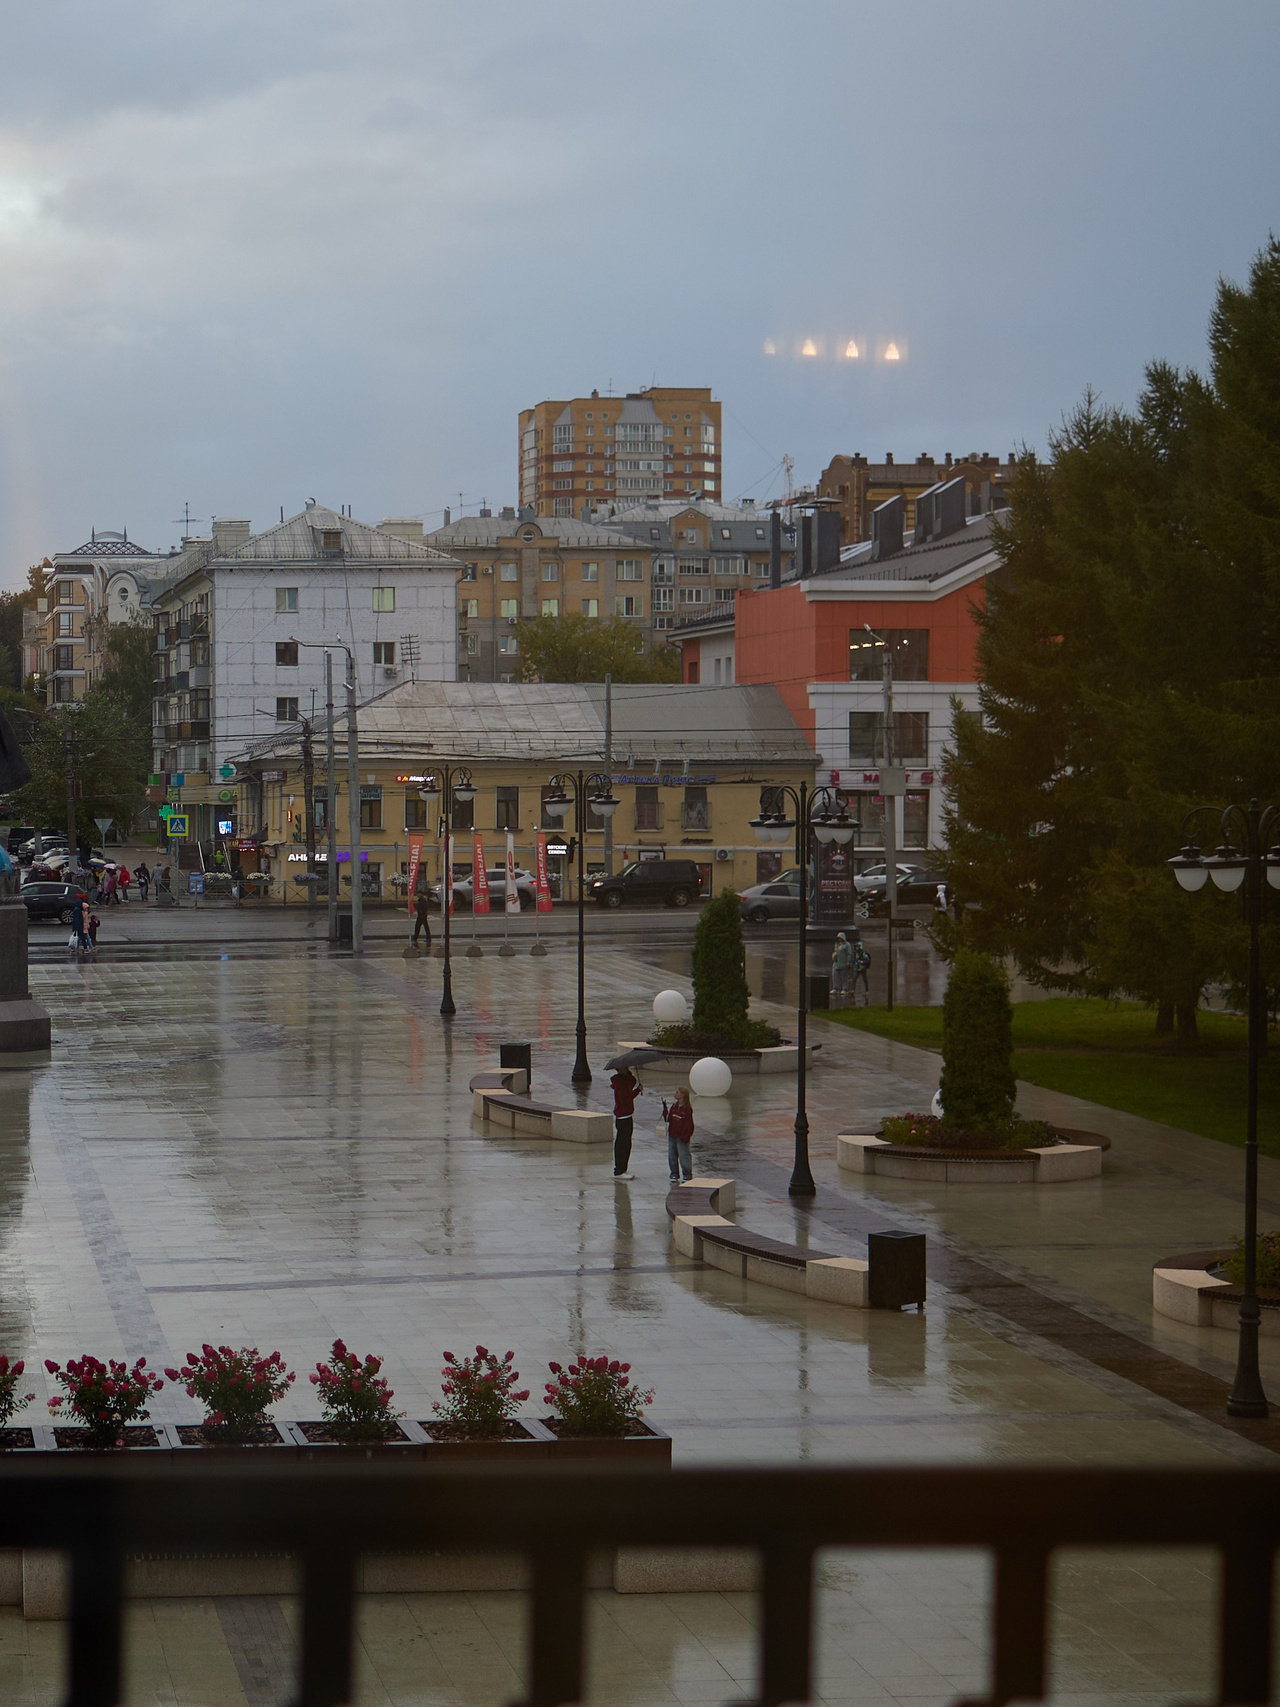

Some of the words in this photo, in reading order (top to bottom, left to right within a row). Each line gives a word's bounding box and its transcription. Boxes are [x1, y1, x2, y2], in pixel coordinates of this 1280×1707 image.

[620, 774, 659, 784] Аптека
[662, 774, 694, 784] Плюс
[863, 774, 910, 783] МАТ
[476, 843, 487, 889] ПОБЕДА!
[538, 842, 548, 888] ПОБЕДА!
